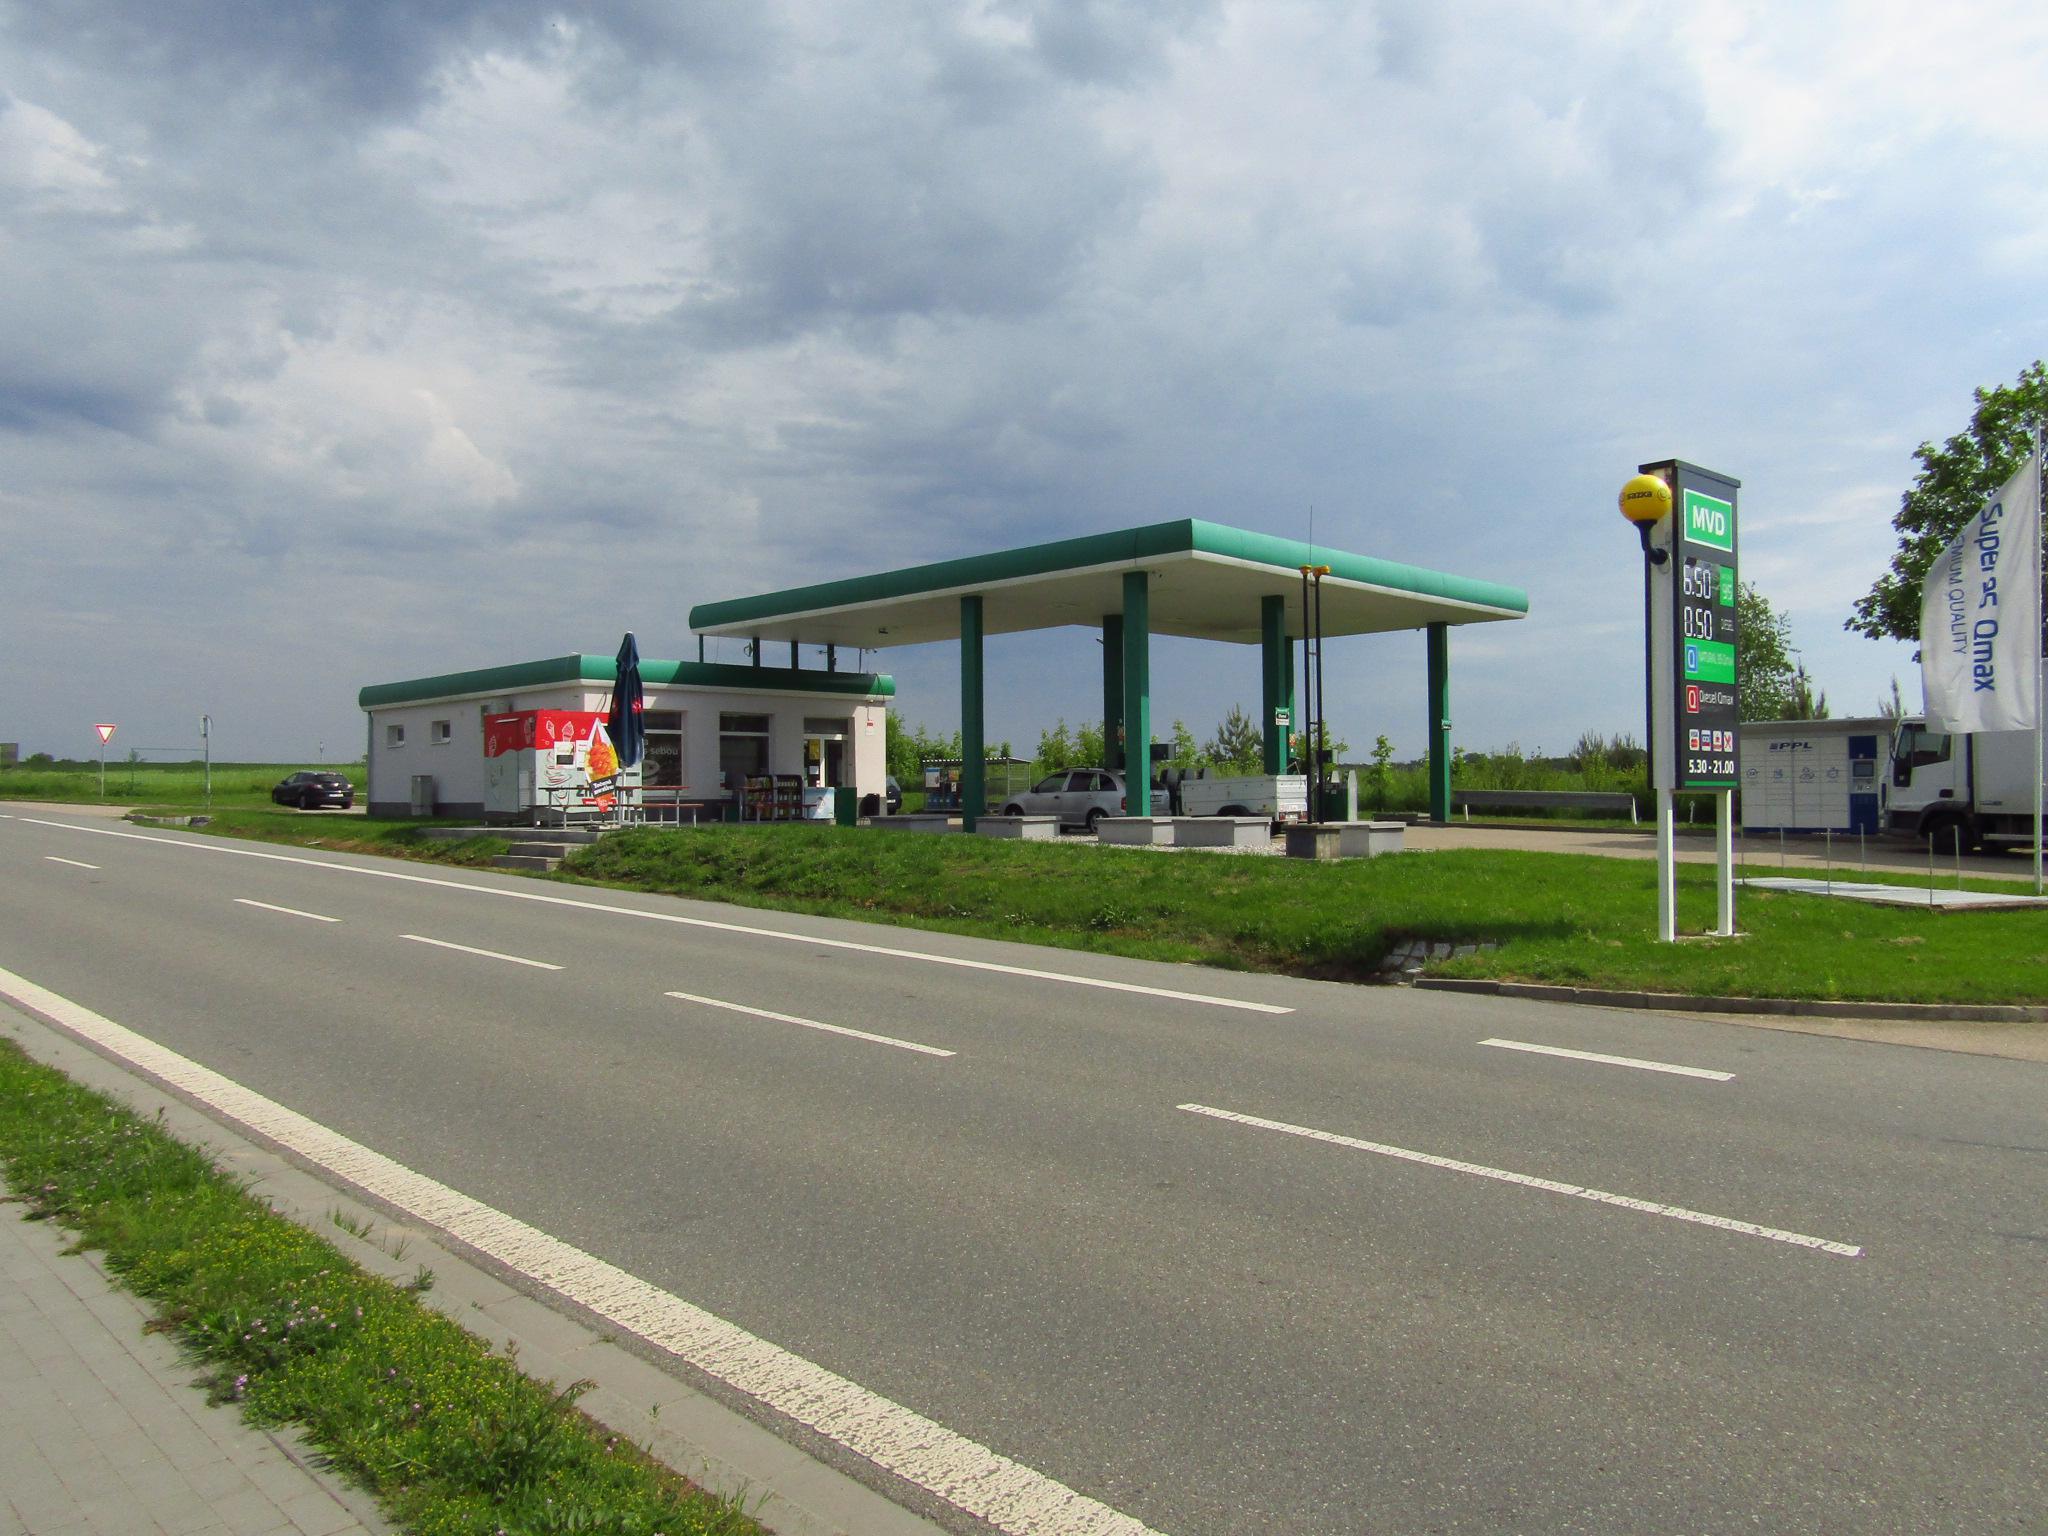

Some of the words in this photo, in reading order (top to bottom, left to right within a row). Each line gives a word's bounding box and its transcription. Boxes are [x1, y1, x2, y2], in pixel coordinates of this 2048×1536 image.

[1692, 504, 1725, 536] MVD
[1973, 502, 2003, 572] Super
[1949, 588, 1968, 655] QUALITY
[1973, 619, 1998, 692] Qmax
[1688, 690, 1697, 709] Q
[1717, 691, 1734, 705] Qmax
[1779, 742, 1813, 750] PPL
[1688, 759, 1707, 773] 5.30
[1712, 760, 1735, 774] 21.00
